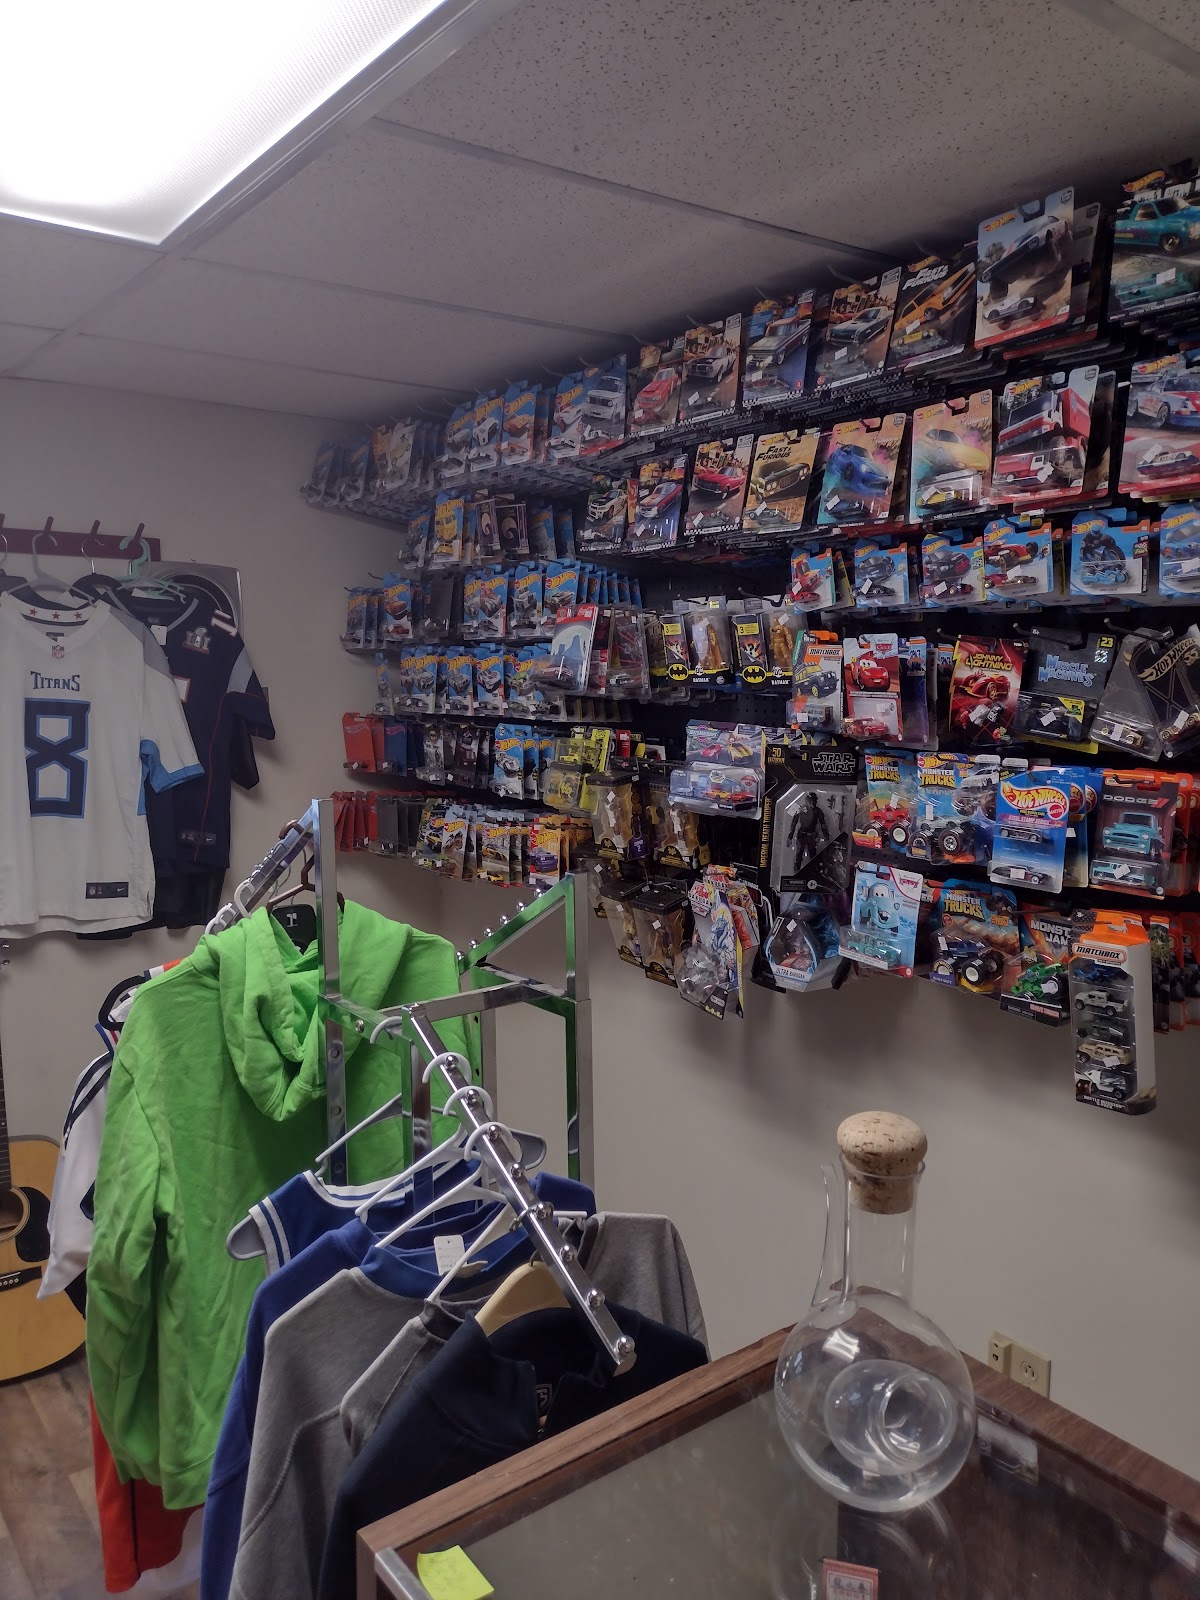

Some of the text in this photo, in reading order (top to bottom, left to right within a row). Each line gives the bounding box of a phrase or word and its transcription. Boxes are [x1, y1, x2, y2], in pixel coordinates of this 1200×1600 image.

[756, 453, 792, 461] FURIOUS
[1100, 637, 1114, 648] 23
[965, 655, 1014, 670] LIGHTNING
[973, 653, 1003, 662] JOHNNY
[1046, 654, 1088, 673] MUSCLE
[1152, 638, 1196, 678] HOT WHEELS
[30, 670, 81, 692] TITANS
[1038, 667, 1094, 687] MACHINES
[24, 697, 91, 819] 8
[812, 752, 856, 763] STAR
[812, 762, 856, 773] WARS
[922, 768, 954, 776] MONSTER
[869, 770, 901, 782] TRUCKS
[920, 774, 956, 788] TRUCKS
[1013, 789, 1036, 809] HOT
[1031, 788, 1067, 806] WHEELS
[1103, 794, 1159, 804] DODGE
[761, 824, 770, 842] DEATH
[946, 892, 982, 904] MONSTER
[944, 899, 985, 920] TRUCKS
[1031, 919, 1072, 937] MONST
[1076, 946, 1121, 960] MATCHBOX
